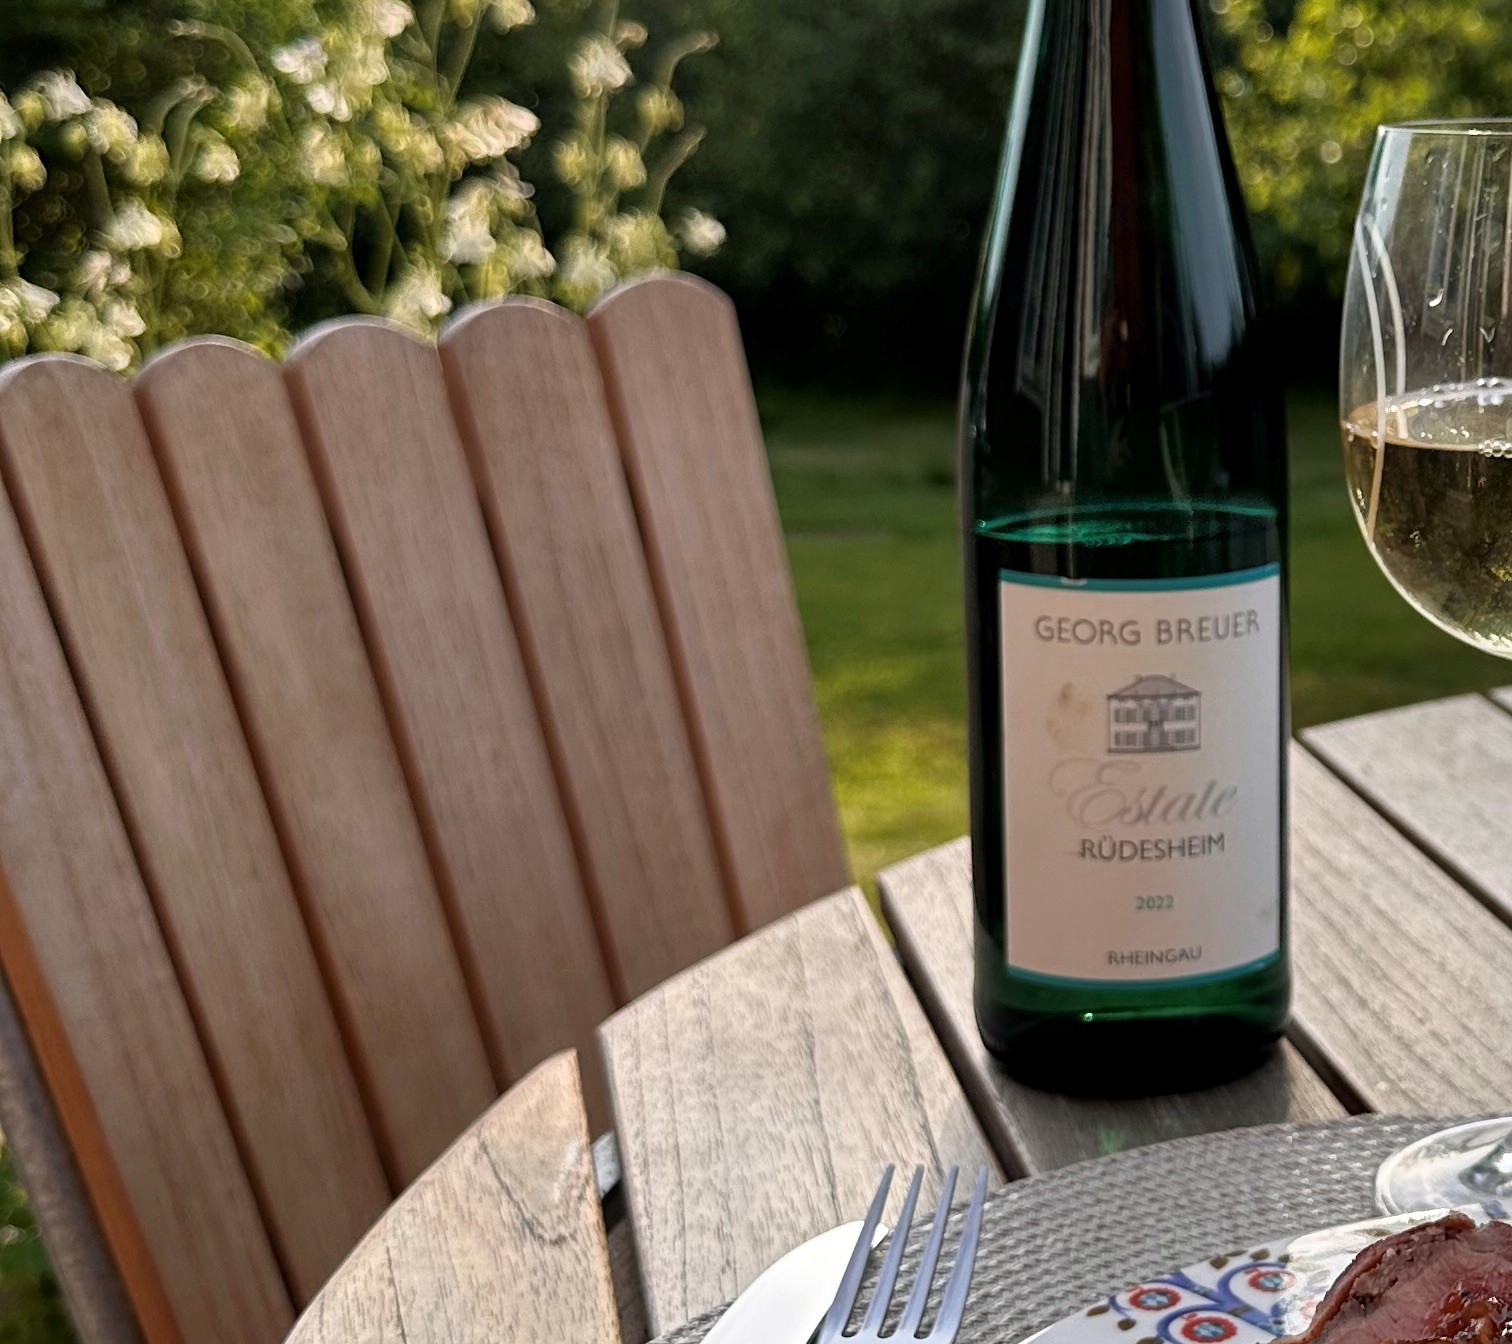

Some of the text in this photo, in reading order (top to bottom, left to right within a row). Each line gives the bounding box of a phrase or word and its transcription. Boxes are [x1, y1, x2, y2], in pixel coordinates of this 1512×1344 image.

[1034, 608, 1260, 646] GEORG BREUER
[1050, 757, 1238, 830] Estate
[1079, 832, 1226, 862] RÜDESHEIM
[1106, 945, 1203, 965] RHEINGAU
